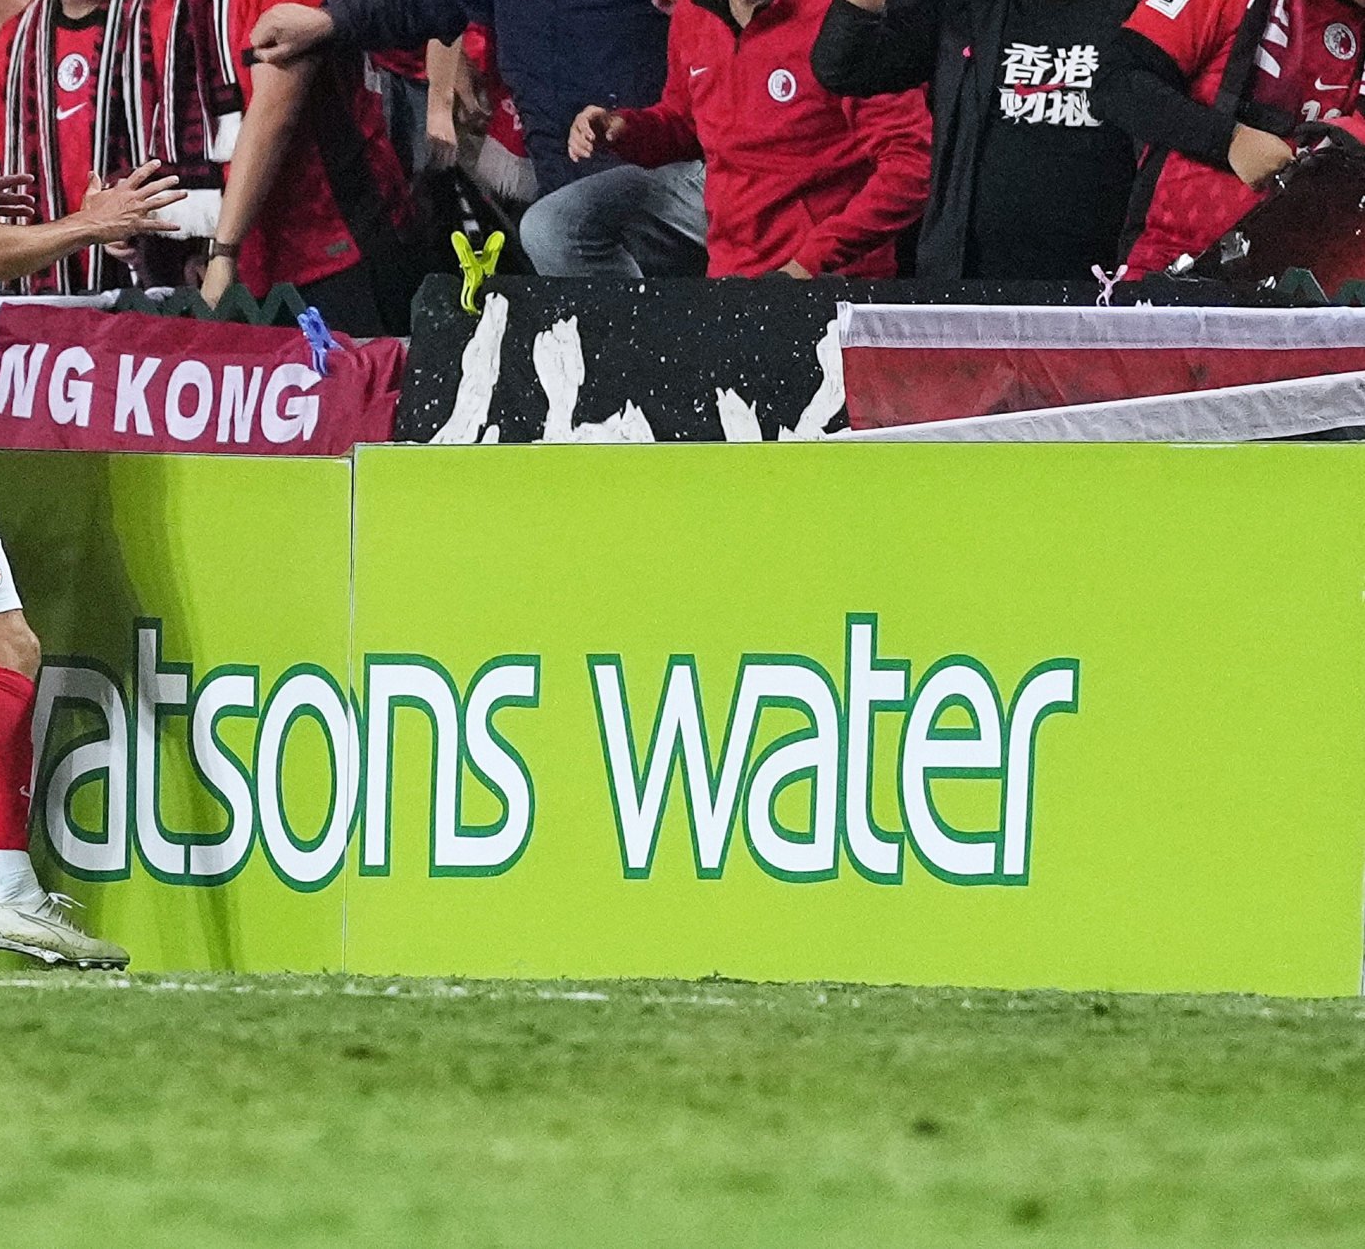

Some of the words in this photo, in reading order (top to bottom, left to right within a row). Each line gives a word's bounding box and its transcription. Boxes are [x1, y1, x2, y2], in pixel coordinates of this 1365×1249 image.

[1001, 42, 1100, 89] 香港
[114, 363, 324, 443] KONG
[586, 612, 1081, 887] water
